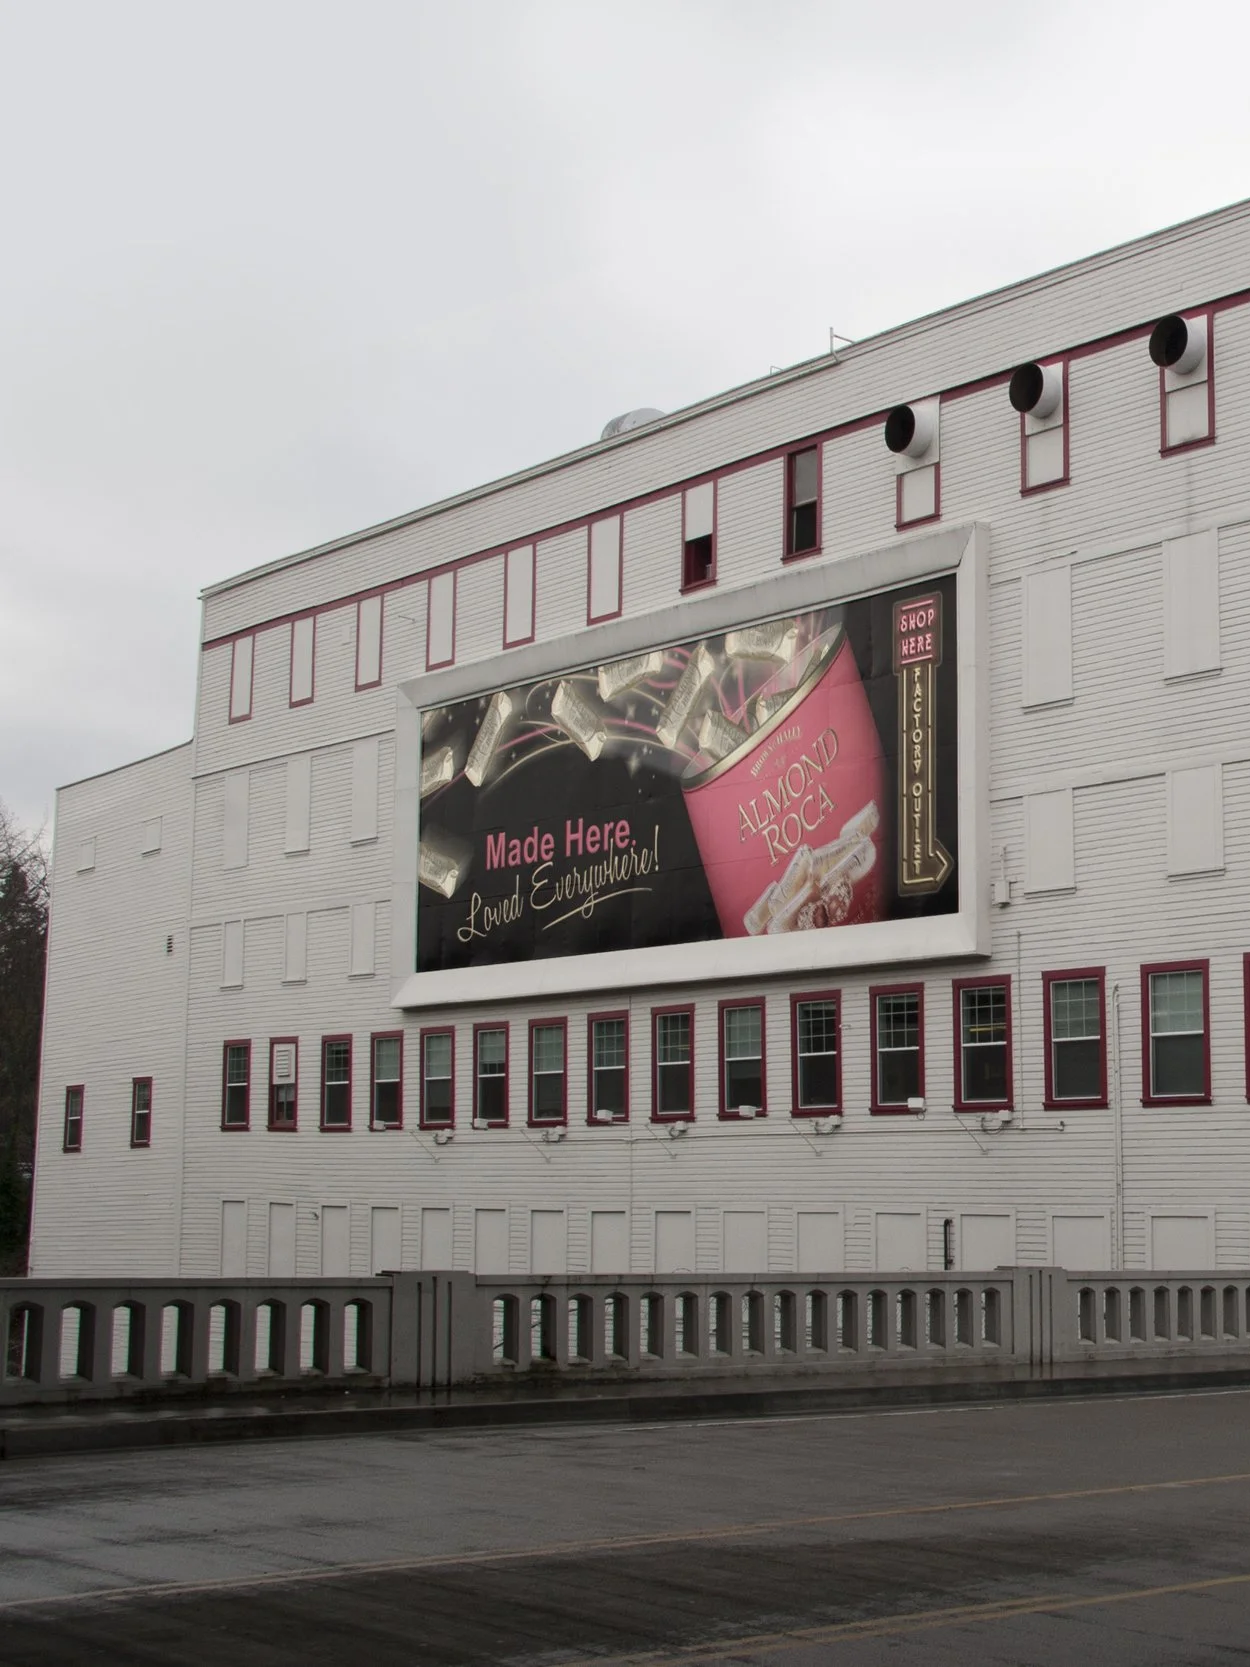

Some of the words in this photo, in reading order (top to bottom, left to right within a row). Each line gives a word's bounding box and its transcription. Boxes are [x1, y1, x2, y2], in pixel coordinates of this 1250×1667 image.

[900, 609, 934, 632] SHOP
[901, 633, 932, 656] HERE
[913, 667, 922, 774] FACTORY
[737, 728, 839, 843] ALMOND
[762, 784, 836, 866] ROCA
[913, 783, 922, 874] OUTLET
[457, 874, 524, 942] Loved
[530, 825, 660, 919] Everywhere!
[486, 826, 555, 871] Made
[565, 818, 637, 857] Here.
